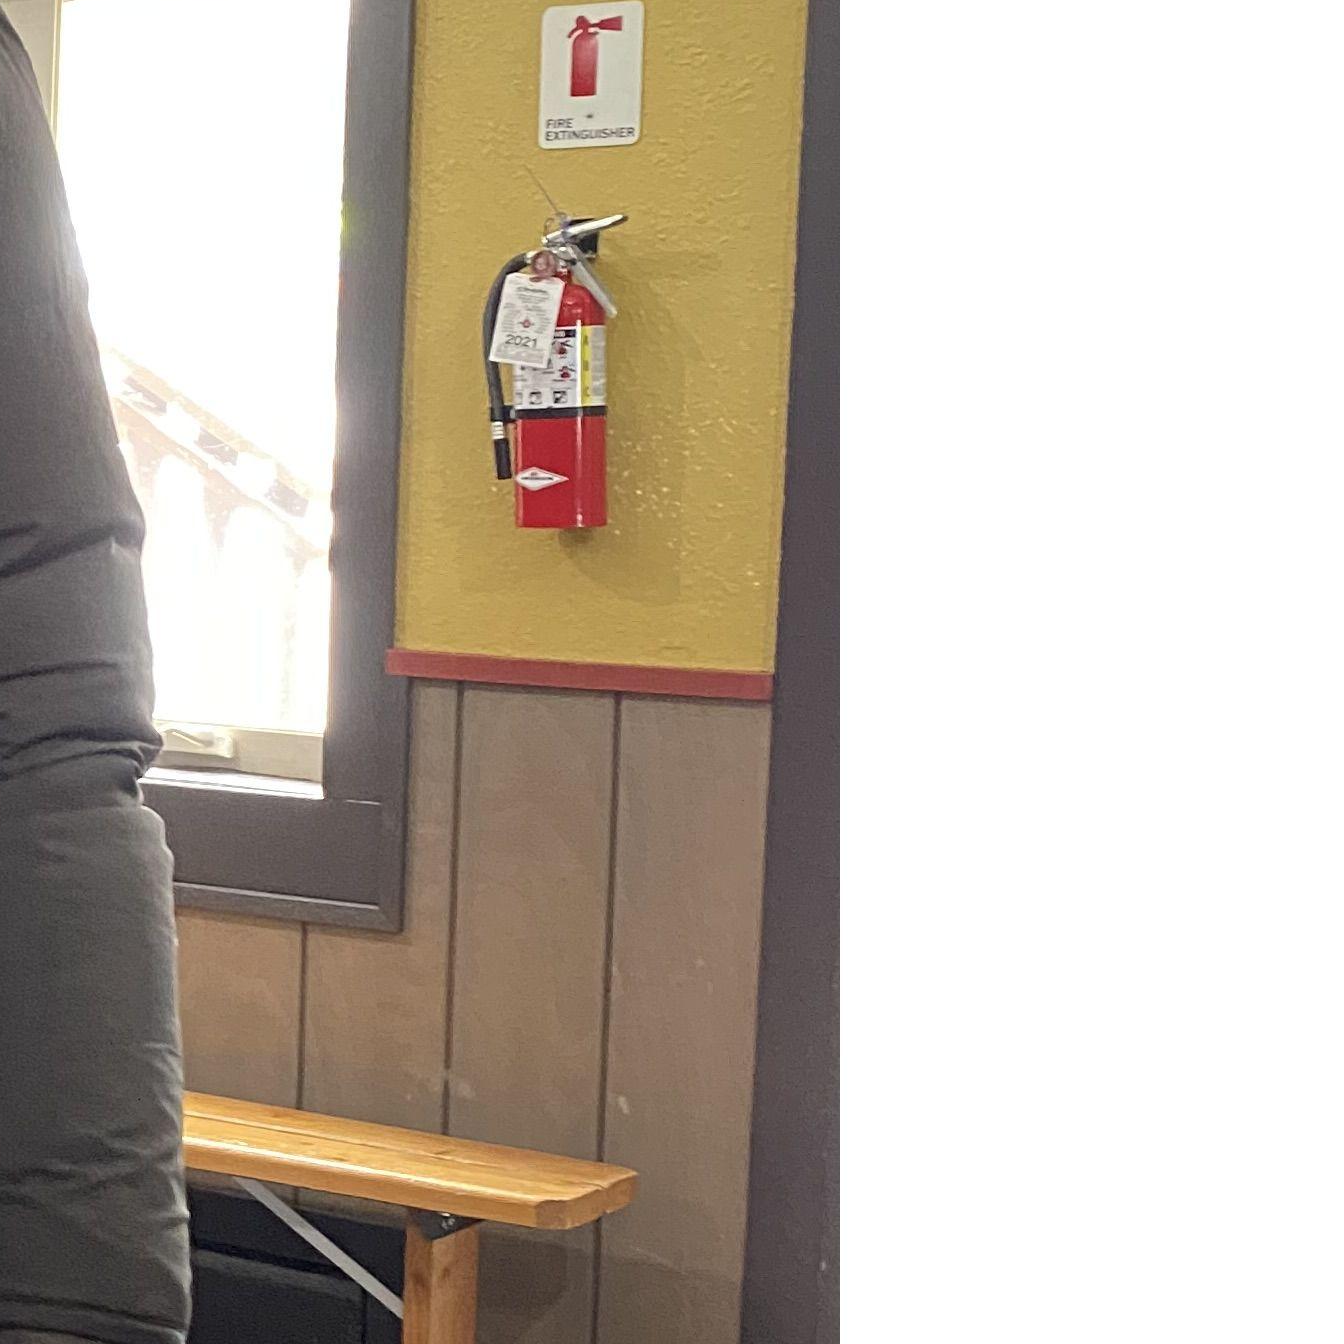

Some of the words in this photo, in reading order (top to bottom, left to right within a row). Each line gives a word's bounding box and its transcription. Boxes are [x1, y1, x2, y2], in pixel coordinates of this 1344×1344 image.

[546, 118, 573, 129] FIRE
[545, 127, 635, 142] EXTINGUISHER
[505, 334, 538, 349] 2021
